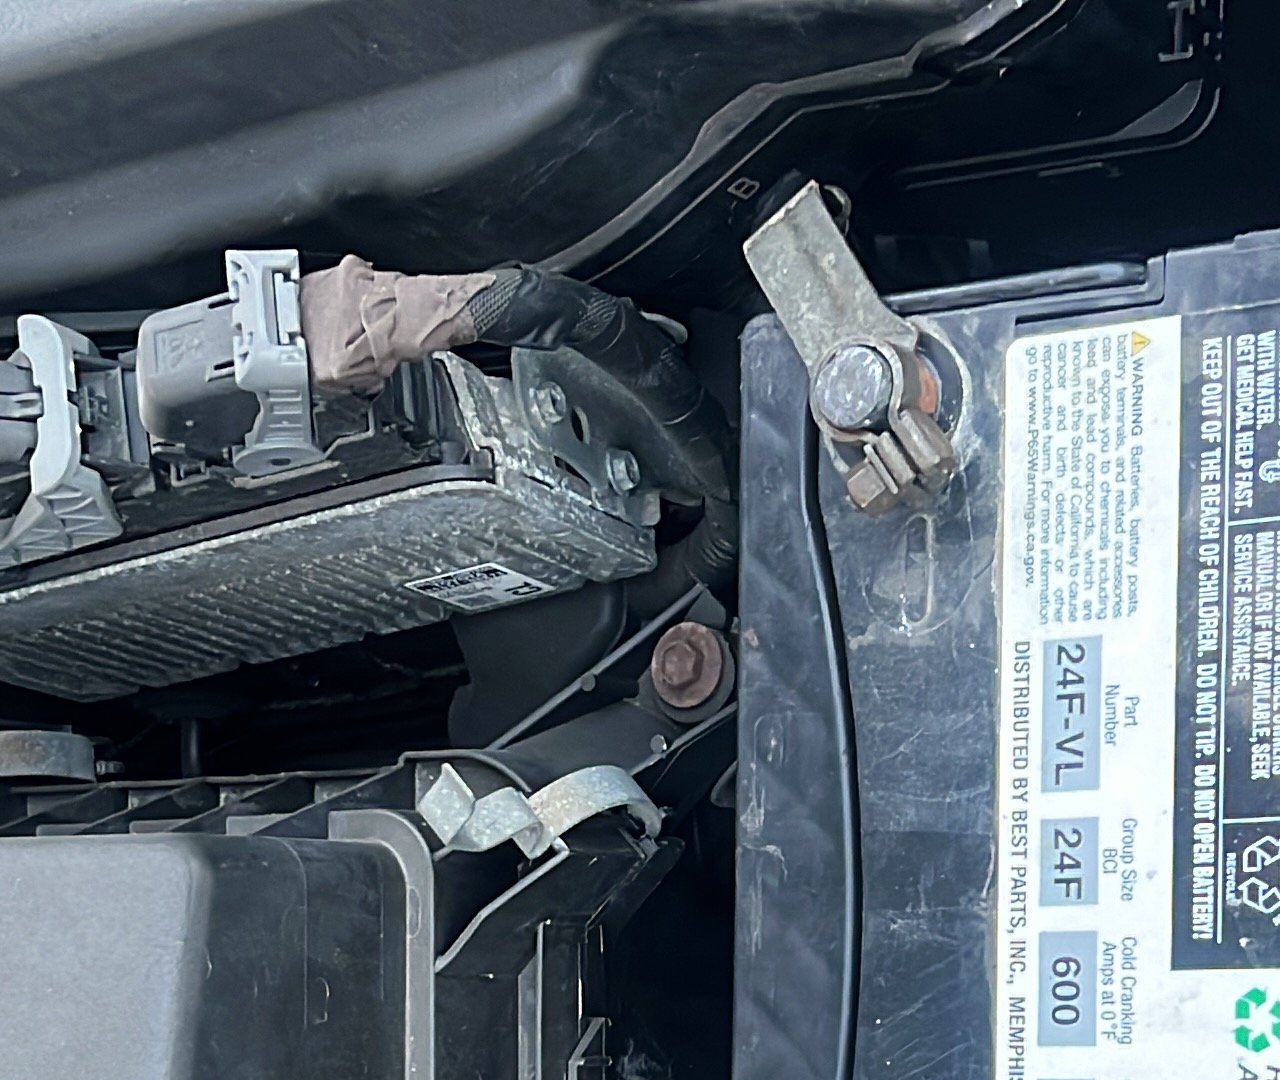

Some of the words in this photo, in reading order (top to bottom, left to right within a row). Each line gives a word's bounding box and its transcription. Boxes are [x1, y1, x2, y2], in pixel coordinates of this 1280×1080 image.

[1025, 347, 1037, 364] go
[1101, 337, 1111, 362] can
[1114, 334, 1128, 381] battery
[1201, 337, 1223, 379] KEEP
[1236, 334, 1255, 363] GET
[1257, 330, 1276, 371] WITH
[1027, 369, 1038, 382] to
[1040, 345, 1053, 430] reproductive
[1131, 357, 1143, 437] WARNING
[1201, 383, 1222, 416] OUT
[1235, 365, 1255, 430] MEDICAL
[1256, 373, 1275, 430] WATER.
[1071, 409, 1082, 432] the
[1098, 428, 1110, 453] you
[1200, 421, 1222, 443] OF
[1070, 436, 1083, 472] State
[1100, 461, 1111, 475] to
[1114, 457, 1126, 483] and
[1200, 447, 1222, 481] THE
[1234, 432, 1253, 470] HELP
[1023, 386, 1038, 587] www.P65Warnings.ca.gov.
[1040, 481, 1052, 502] For
[1070, 476, 1082, 489] of
[1129, 446, 1142, 512] Batteries,
[1234, 472, 1252, 514] FAST.
[1040, 508, 1050, 543] more
[1069, 494, 1082, 559] California
[1098, 481, 1111, 550] chemicals
[1113, 490, 1126, 534] related
[1199, 484, 1221, 540] REACH
[1125, 519, 1141, 567] battery
[1199, 544, 1220, 565] OF
[1233, 534, 1252, 593] SERVICE
[1255, 532, 1273, 590] MANUAL
[1039, 549, 1051, 625] information
[1069, 562, 1080, 577] to
[1095, 557, 1109, 620] including
[1113, 541, 1124, 619] accessories
[1068, 581, 1079, 622] cause
[1197, 569, 1220, 658] CHILDREN.
[1254, 591, 1273, 612] OR
[1254, 615, 1272, 629] IF
[1231, 596, 1251, 686] ASSISTANCE.
[1253, 631, 1272, 661] NOT
[1195, 663, 1217, 688] DO
[1011, 641, 1031, 770] DISTRIBUTED
[1054, 642, 1086, 786] 24F-VL
[1103, 684, 1119, 746] Number
[1123, 696, 1139, 727] Part
[1194, 691, 1216, 725] NOT
[1248, 662, 1271, 742] AVAILABLE,
[1194, 728, 1215, 759] TIP.
[1251, 744, 1270, 780] SEEK
[1011, 777, 1029, 803] BY
[1194, 765, 1215, 788] DO
[1193, 790, 1215, 820] NOT
[1010, 810, 1028, 860] BEST
[1119, 818, 1137, 864] Group
[1193, 823, 1214, 863] OPEN
[1052, 827, 1082, 900] 24F
[1101, 848, 1117, 874] BCI
[1225, 853, 1236, 901] RECYCLE
[1007, 867, 1027, 934] PARTS,
[1121, 870, 1136, 901] Size
[1192, 866, 1214, 940] BATTERY!
[1006, 940, 1026, 984] INC.,
[1098, 941, 1117, 985] Amps
[1120, 936, 1136, 970] Cold
[1051, 956, 1080, 1026] 600
[1101, 990, 1115, 1005] at
[1117, 975, 1135, 1045] Cranking
[1101, 1010, 1117, 1040] 0°F
